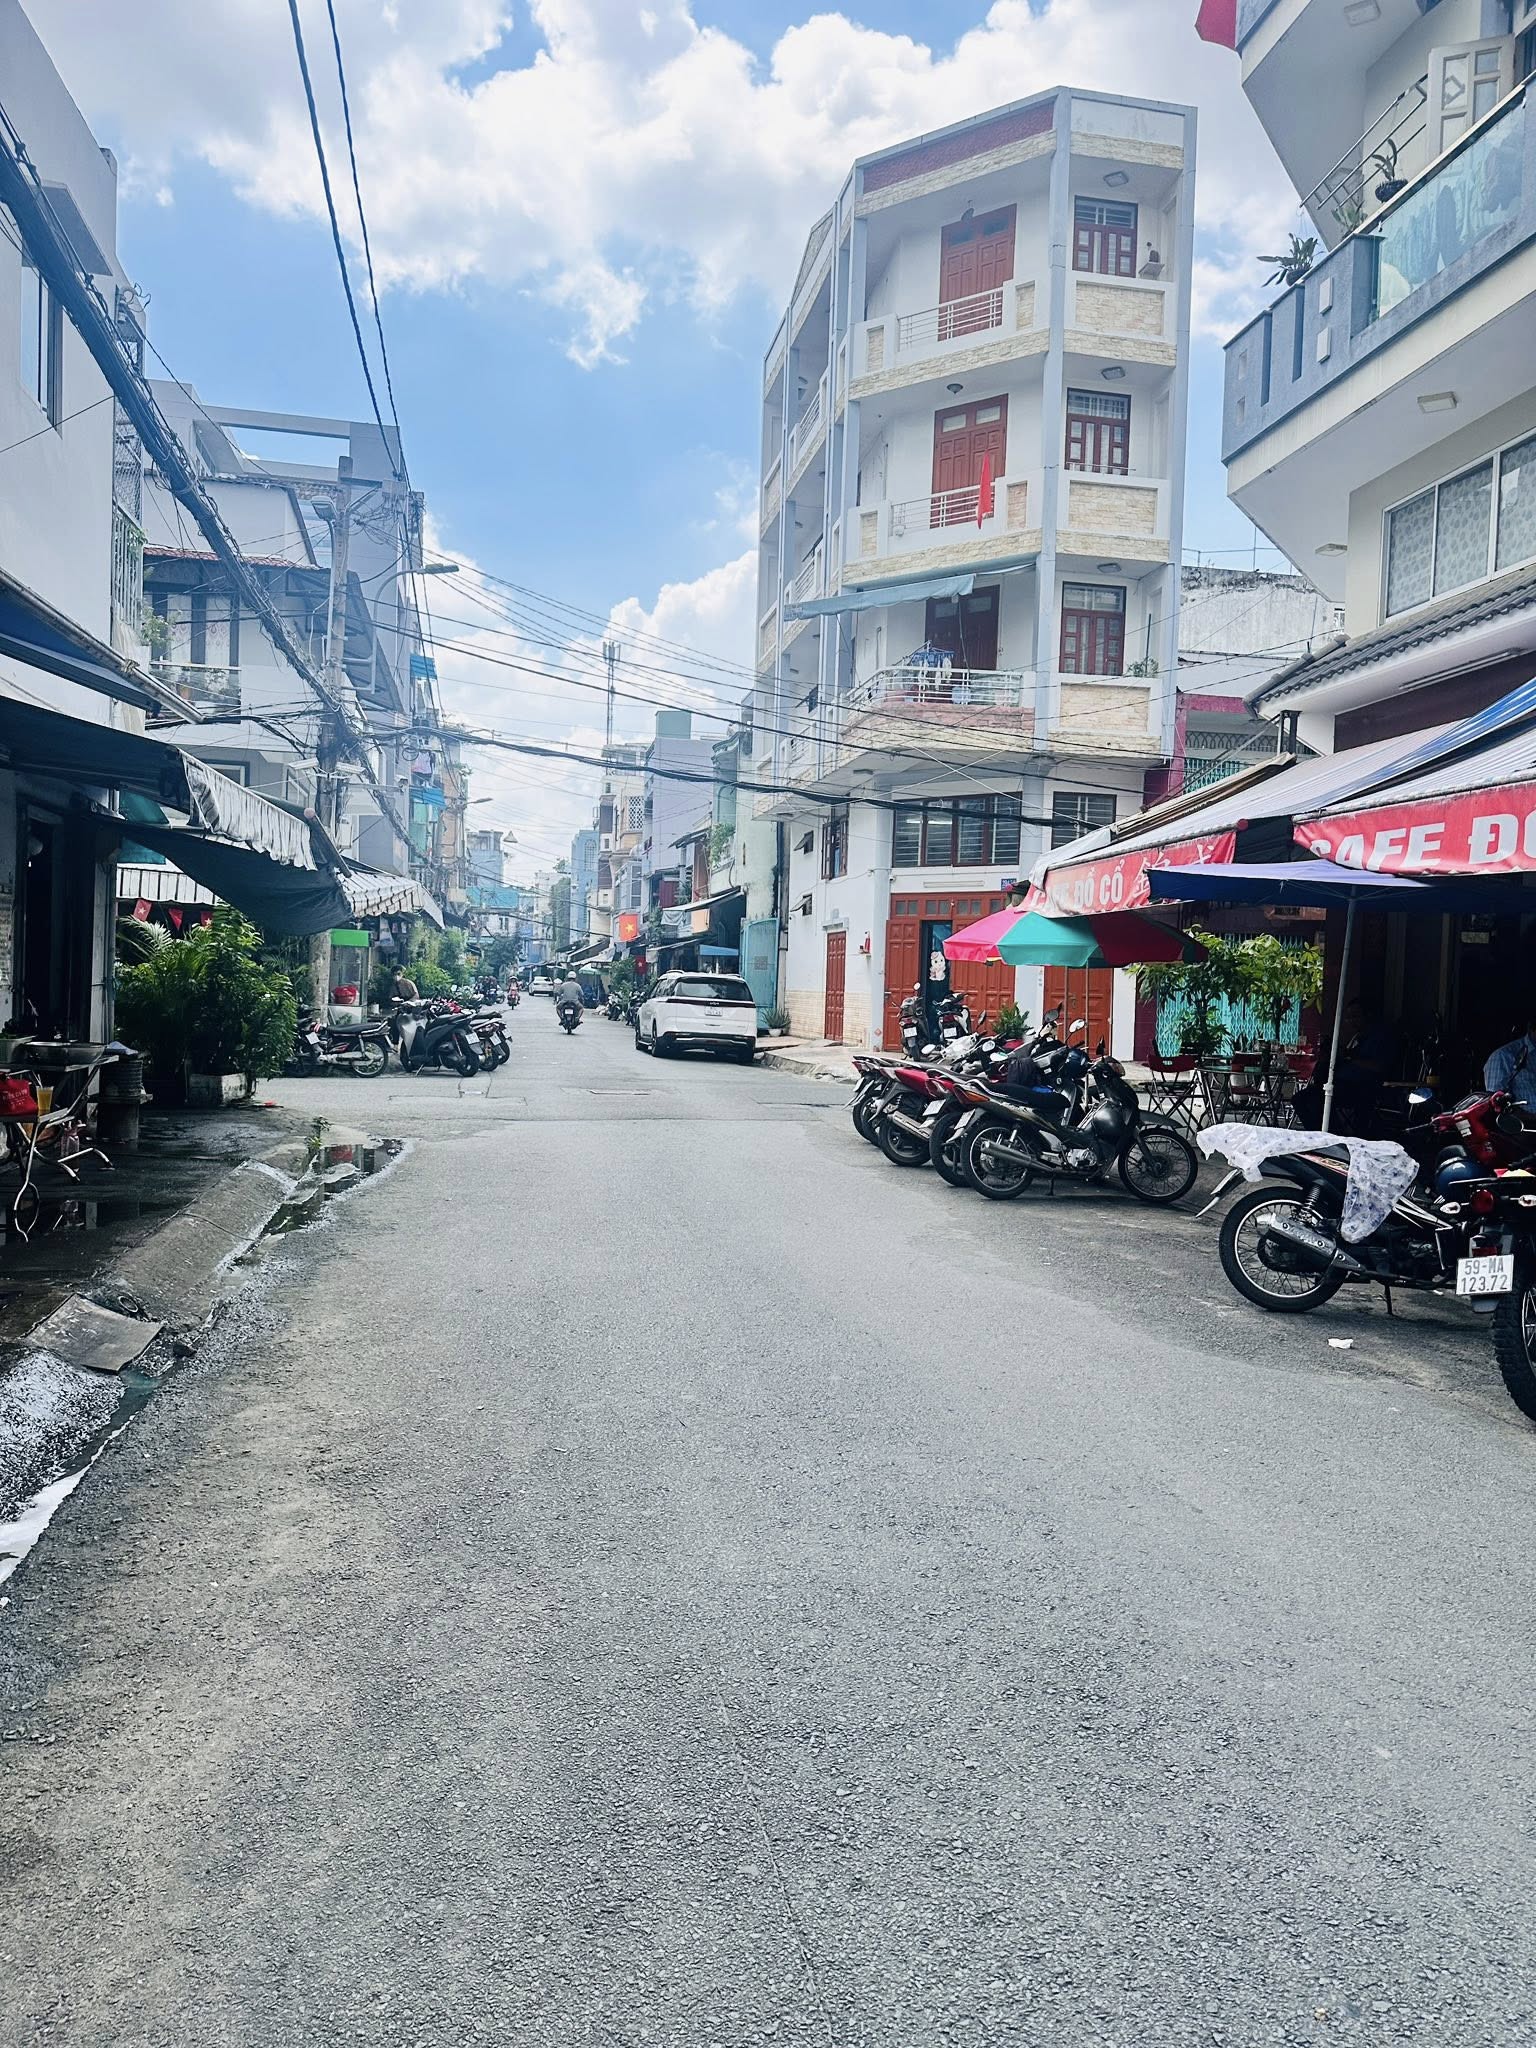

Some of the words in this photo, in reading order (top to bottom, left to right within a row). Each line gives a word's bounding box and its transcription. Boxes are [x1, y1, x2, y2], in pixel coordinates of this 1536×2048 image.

[1467, 809, 1536, 865] Đ
[1099, 858, 1125, 905] CỔ
[1464, 1257, 1504, 1276] 59-MA
[1461, 1274, 1508, 1293] 123.72
